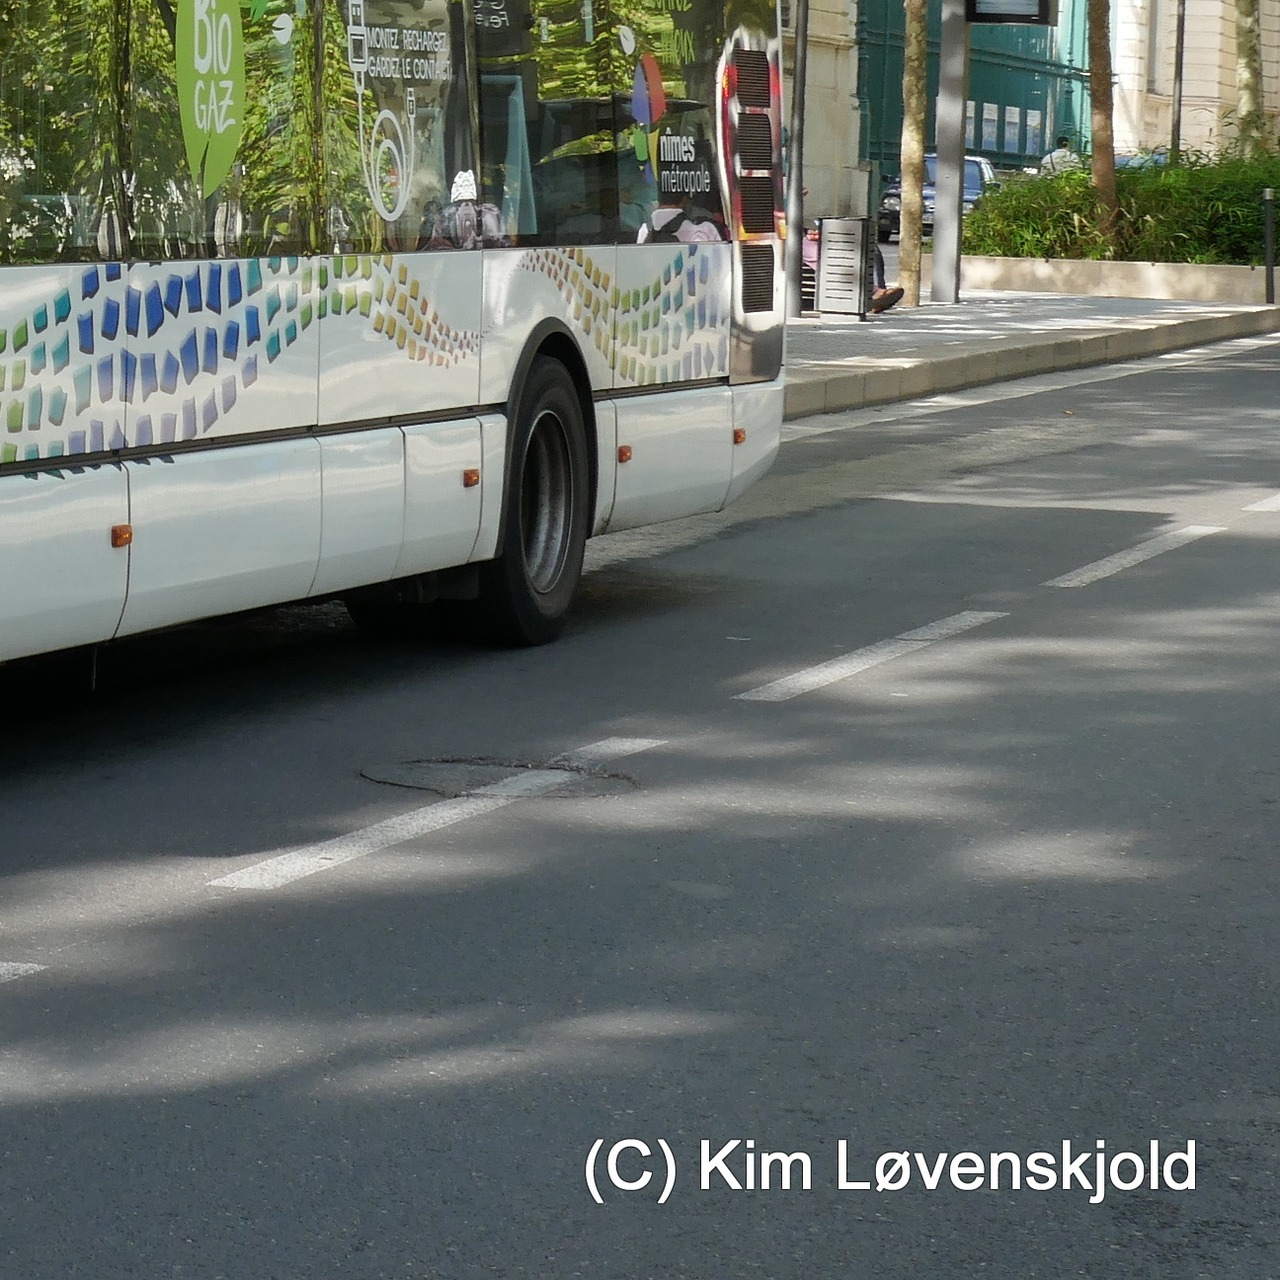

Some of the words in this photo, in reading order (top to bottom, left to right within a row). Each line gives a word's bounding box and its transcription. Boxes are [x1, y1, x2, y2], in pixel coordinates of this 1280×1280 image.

[368, 56, 400, 78] GARDEZ
[401, 57, 412, 79] LE
[194, 79, 236, 134] GAZ
[660, 126, 695, 162] nîmes
[661, 163, 711, 198] métropole
